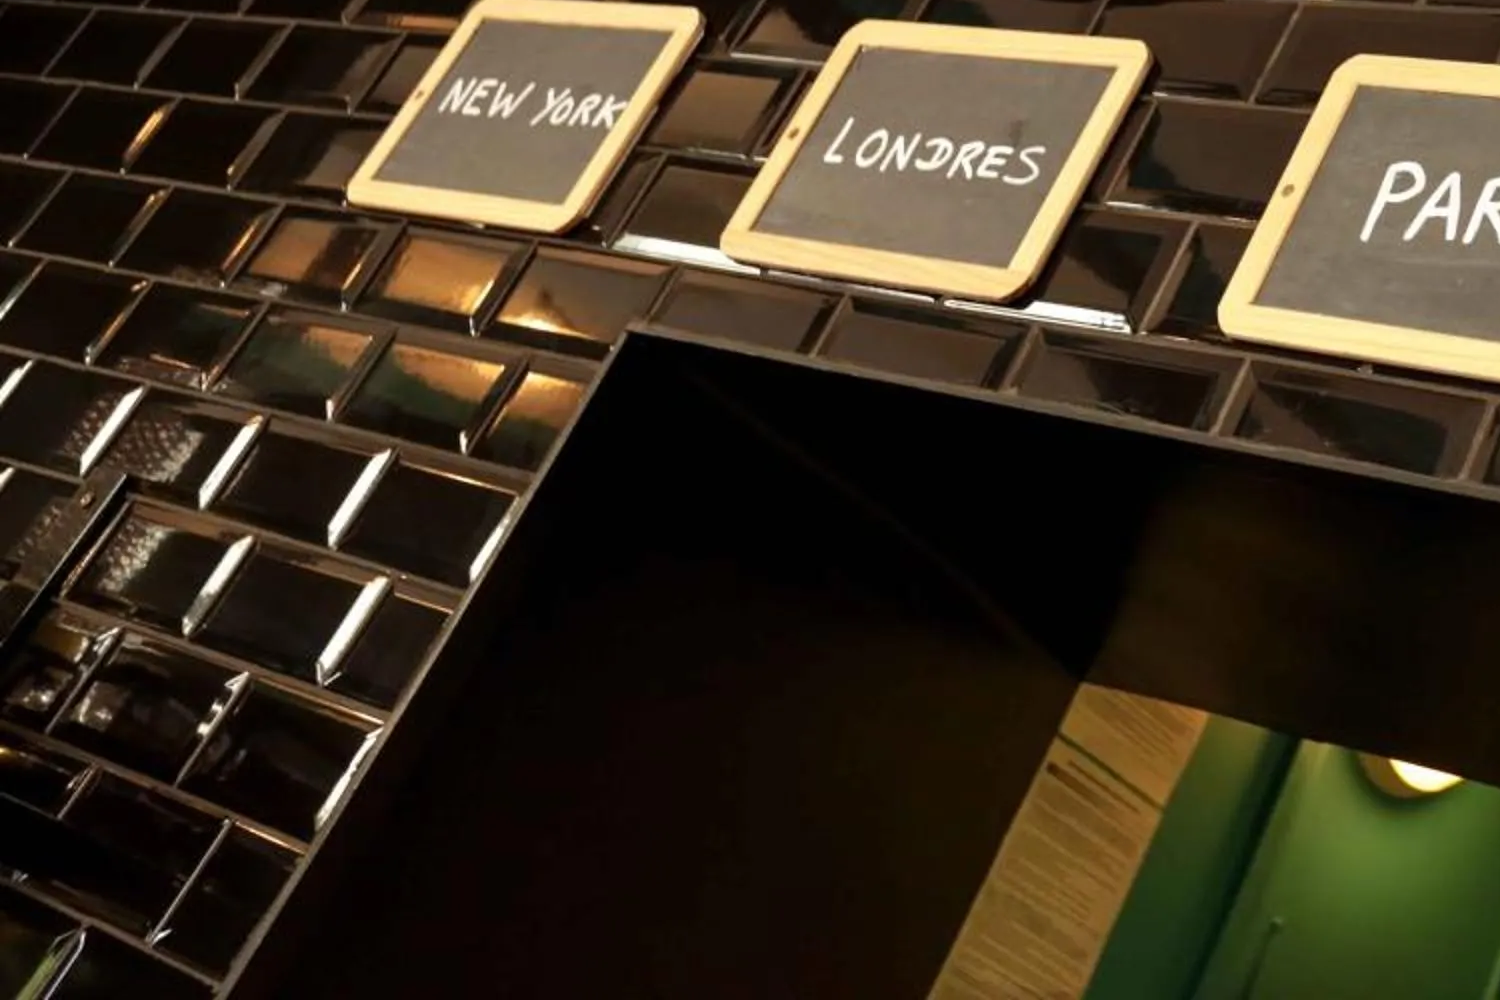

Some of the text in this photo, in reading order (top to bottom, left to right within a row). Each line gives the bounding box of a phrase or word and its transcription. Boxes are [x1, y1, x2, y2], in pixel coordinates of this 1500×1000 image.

[438, 77, 629, 130] NEW YORK
[823, 116, 1046, 186] LONDRES
